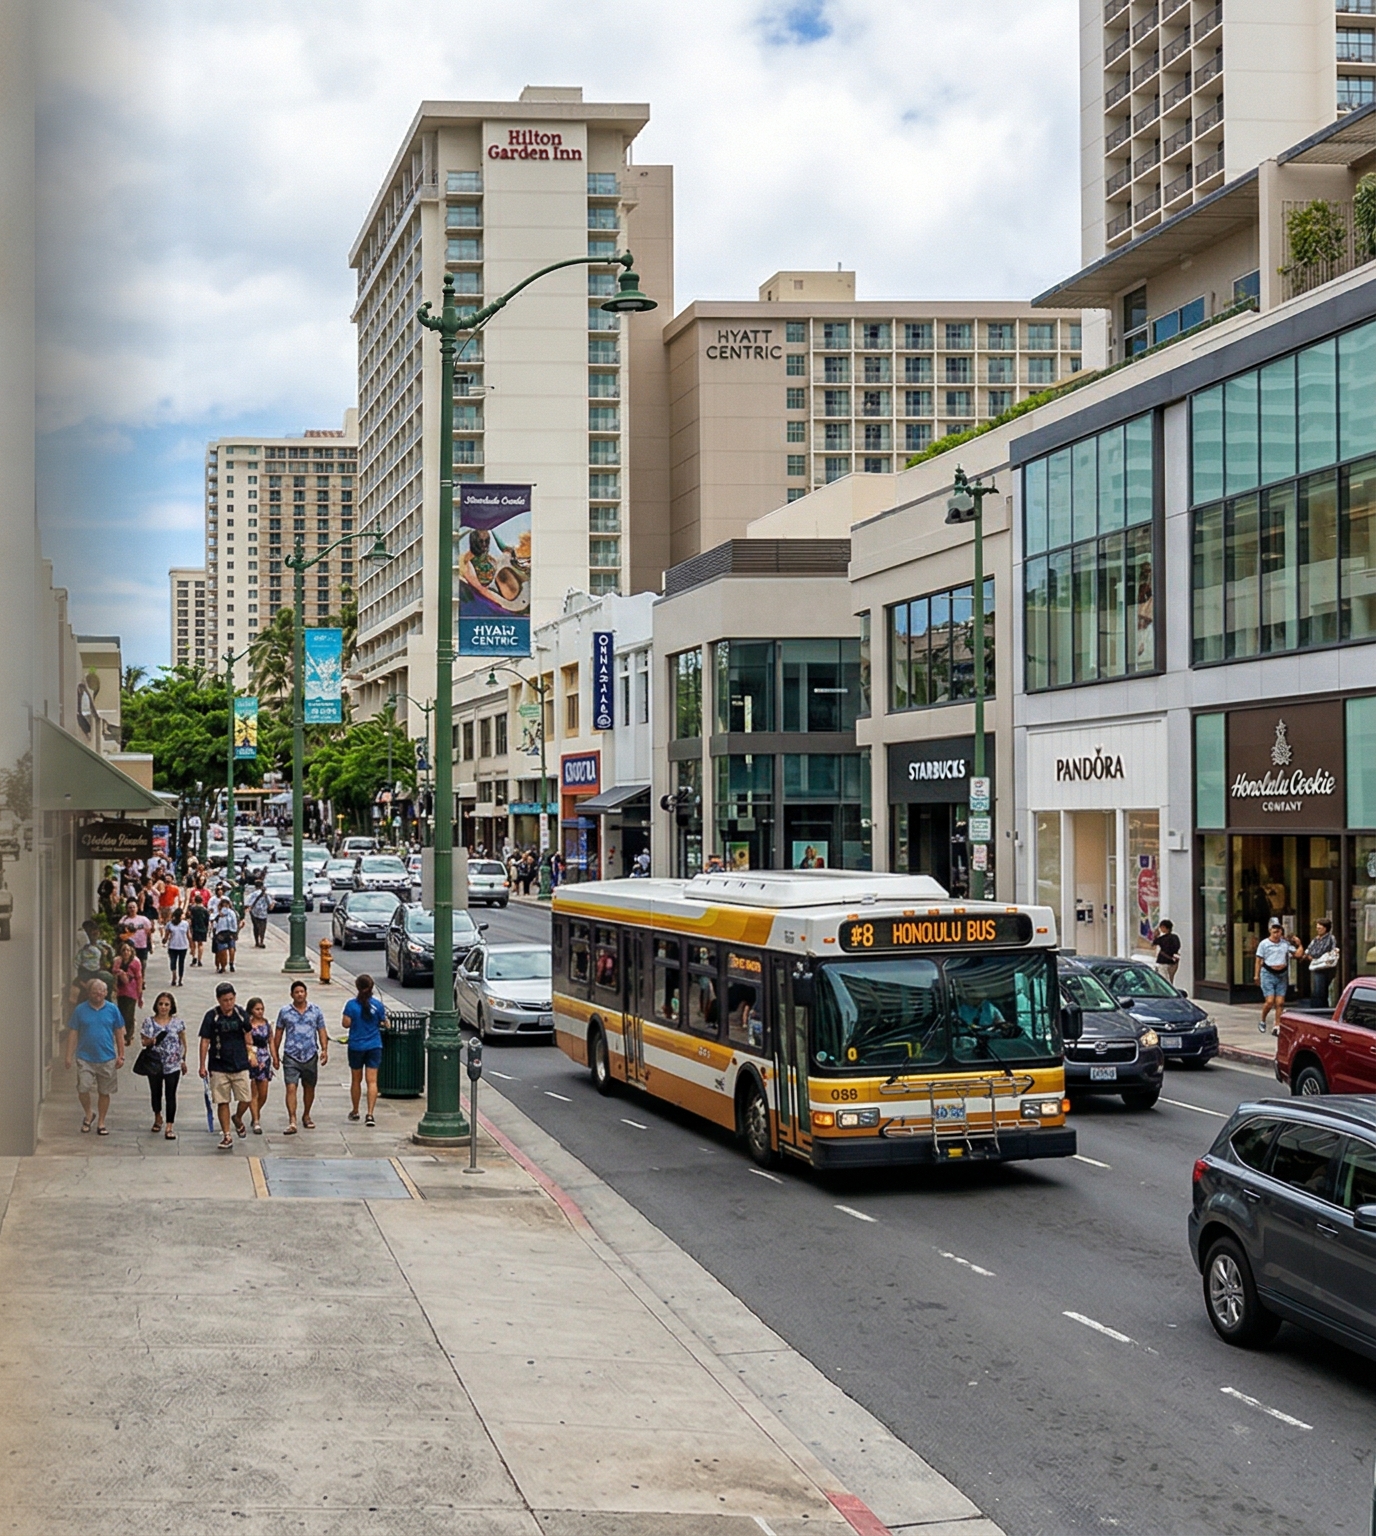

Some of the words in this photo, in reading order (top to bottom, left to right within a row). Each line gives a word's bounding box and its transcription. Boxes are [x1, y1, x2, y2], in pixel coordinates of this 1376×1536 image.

[508, 129, 562, 146] Hilton
[488, 144, 550, 160] Garden
[552, 145, 582, 160] Inn
[717, 330, 772, 344] HYATT
[706, 346, 782, 360] CENTRIC
[909, 759, 965, 780] STARBUCKS
[1057, 754, 1125, 781] PANDORA
[967, 920, 996, 940] BUS
